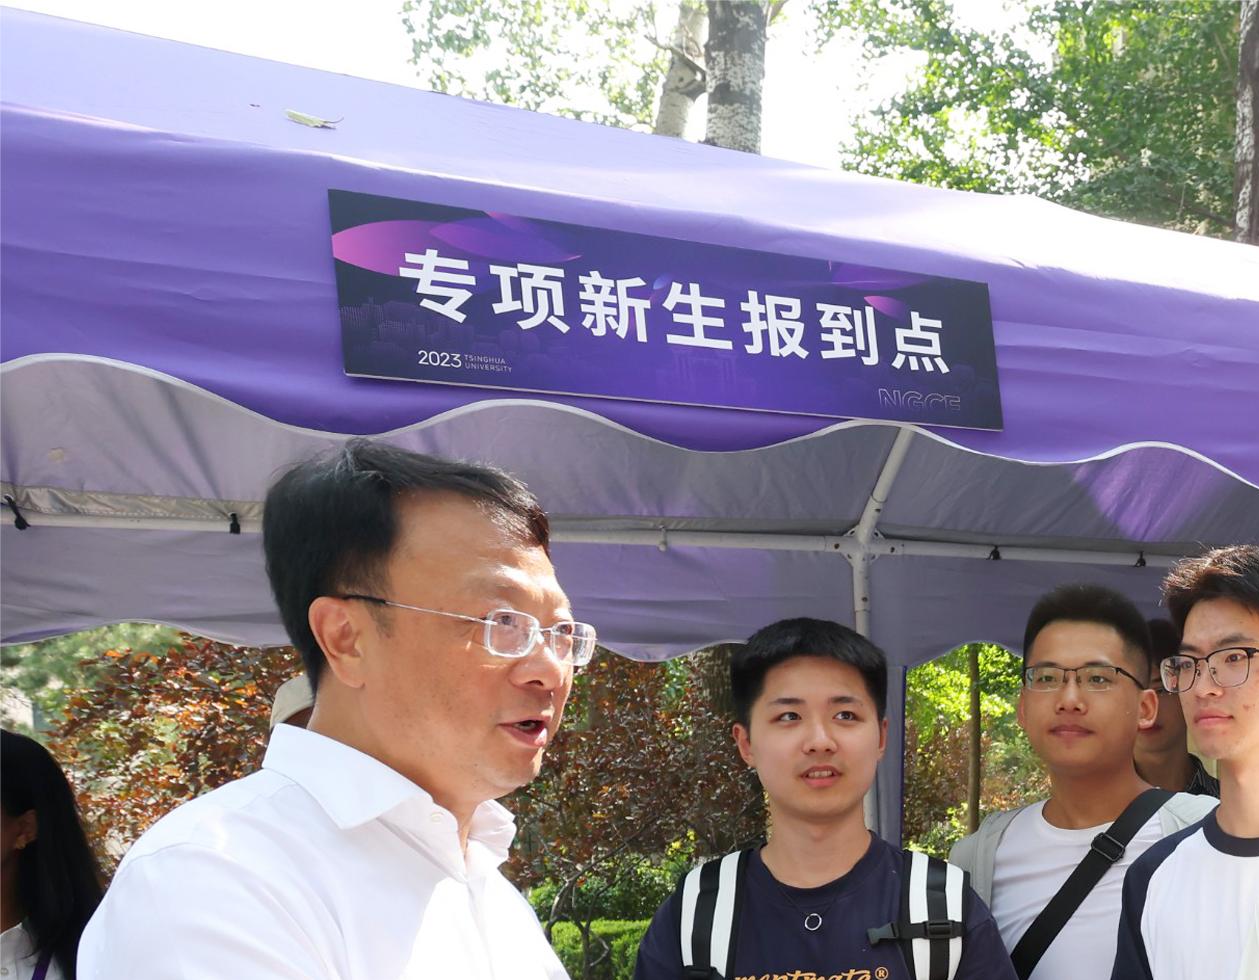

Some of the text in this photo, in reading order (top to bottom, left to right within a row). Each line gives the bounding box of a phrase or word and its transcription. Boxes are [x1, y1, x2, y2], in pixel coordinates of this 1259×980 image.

[399, 248, 951, 376] 专项新生报到点
[417, 350, 462, 368] 2023
[464, 354, 506, 365] TSINGHUA
[464, 362, 512, 373] UNIVERSITY
